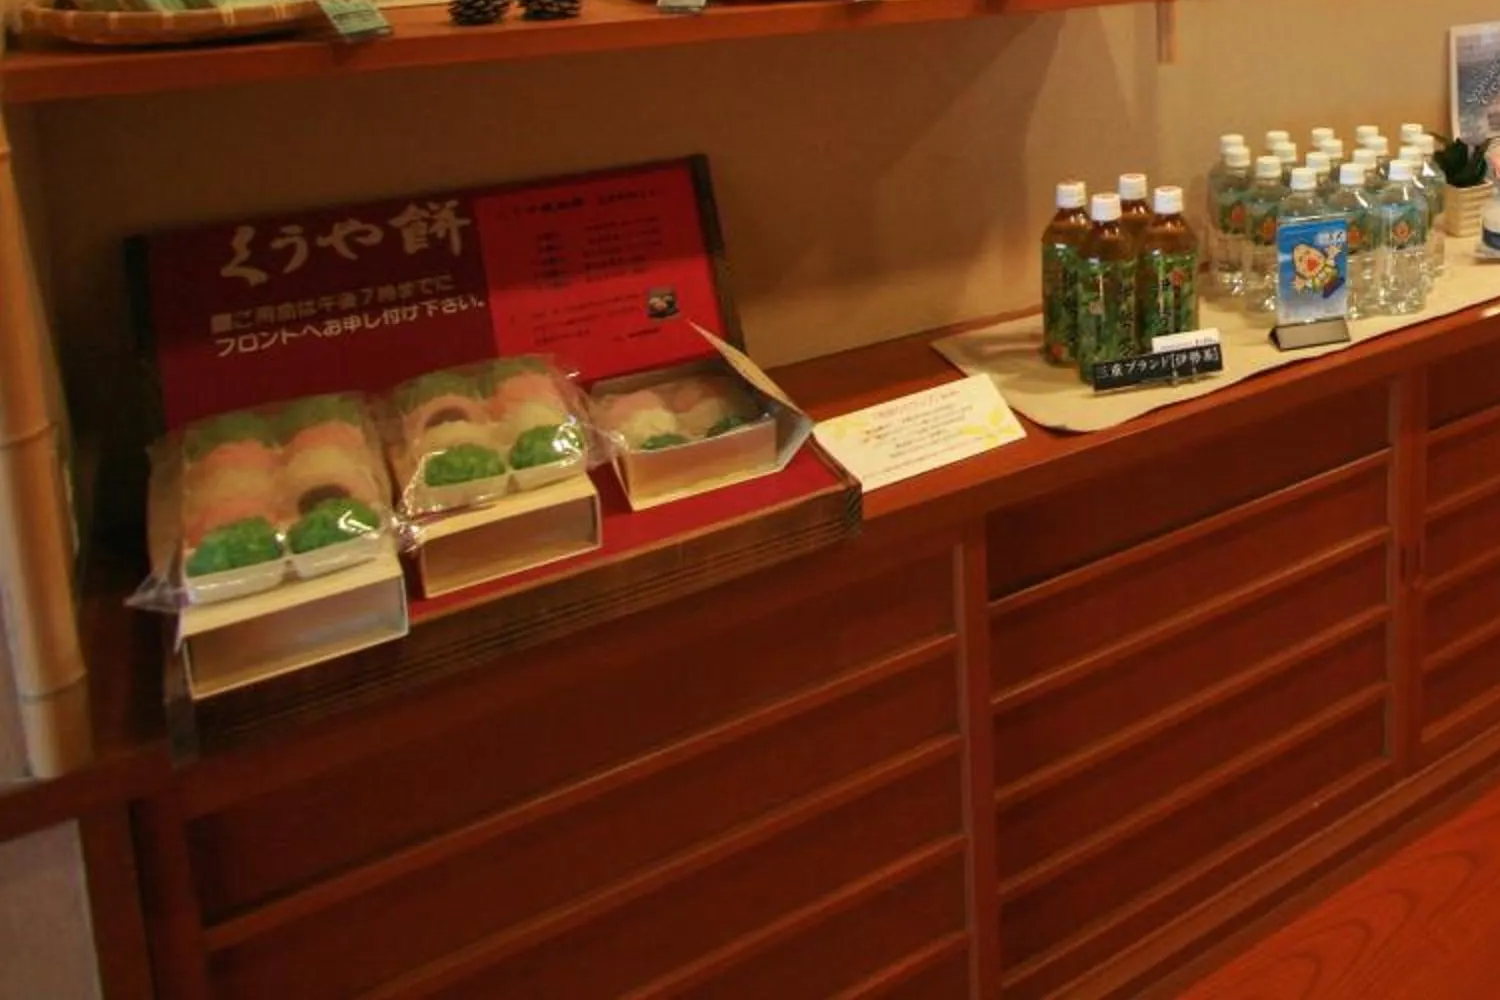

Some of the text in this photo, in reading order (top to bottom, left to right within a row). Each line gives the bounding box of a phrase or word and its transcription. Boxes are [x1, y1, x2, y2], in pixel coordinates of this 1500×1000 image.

[218, 198, 472, 288] くうや餅
[213, 294, 487, 358] フロントへお申し付け下さい。
